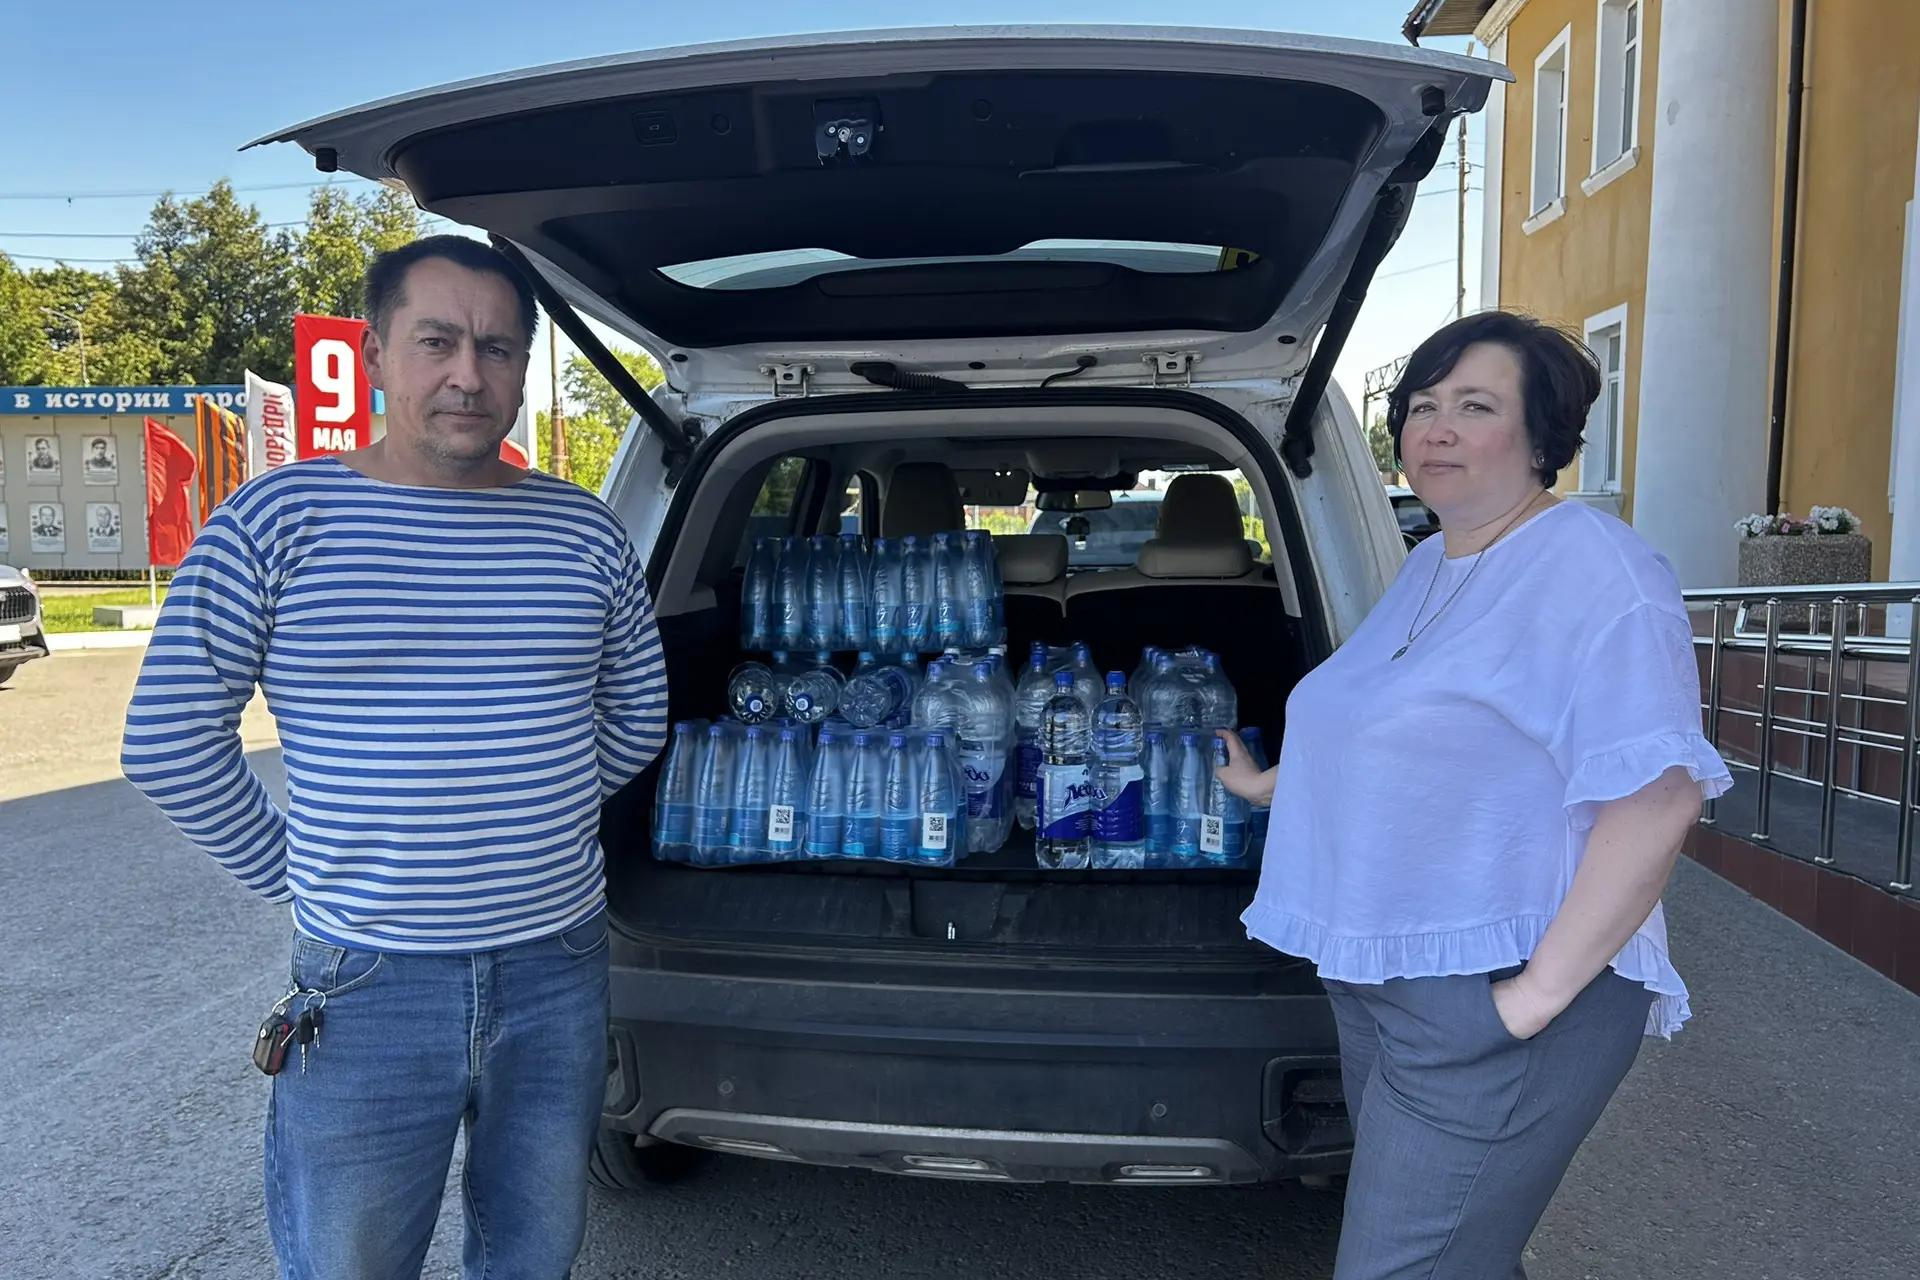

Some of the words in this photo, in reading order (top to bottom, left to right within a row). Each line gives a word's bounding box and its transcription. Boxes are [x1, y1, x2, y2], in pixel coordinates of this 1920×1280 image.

[311, 338, 355, 423] 9
[44, 392, 171, 413] истории
[312, 427, 357, 451] МАЯ
